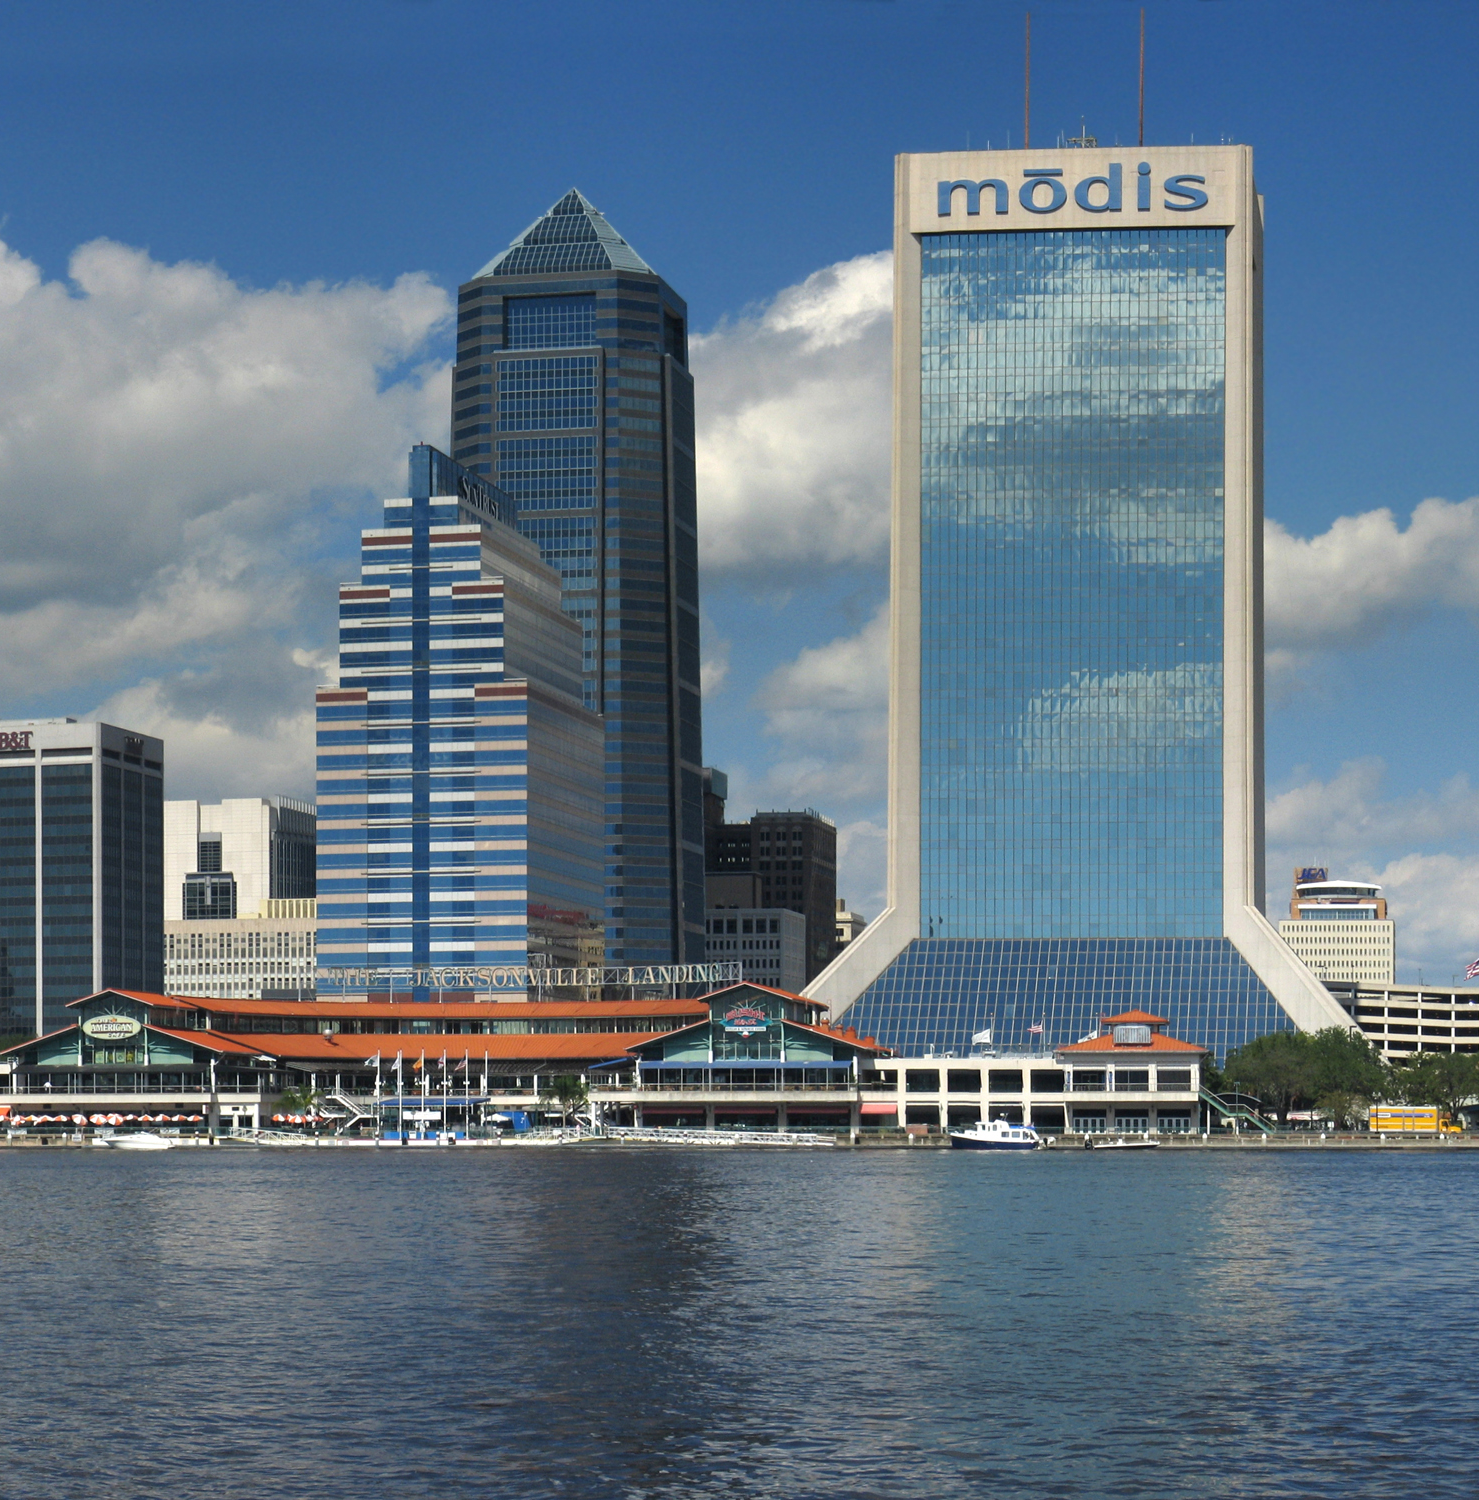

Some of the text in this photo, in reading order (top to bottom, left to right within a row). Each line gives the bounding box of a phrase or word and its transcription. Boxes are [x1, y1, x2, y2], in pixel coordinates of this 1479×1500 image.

[937, 161, 1209, 217] mōdis
[1297, 867, 1326, 880] JEA
[329, 962, 720, 988] THE JACKSONVILLE LANDING
[91, 1023, 133, 1032] AMERICAN
